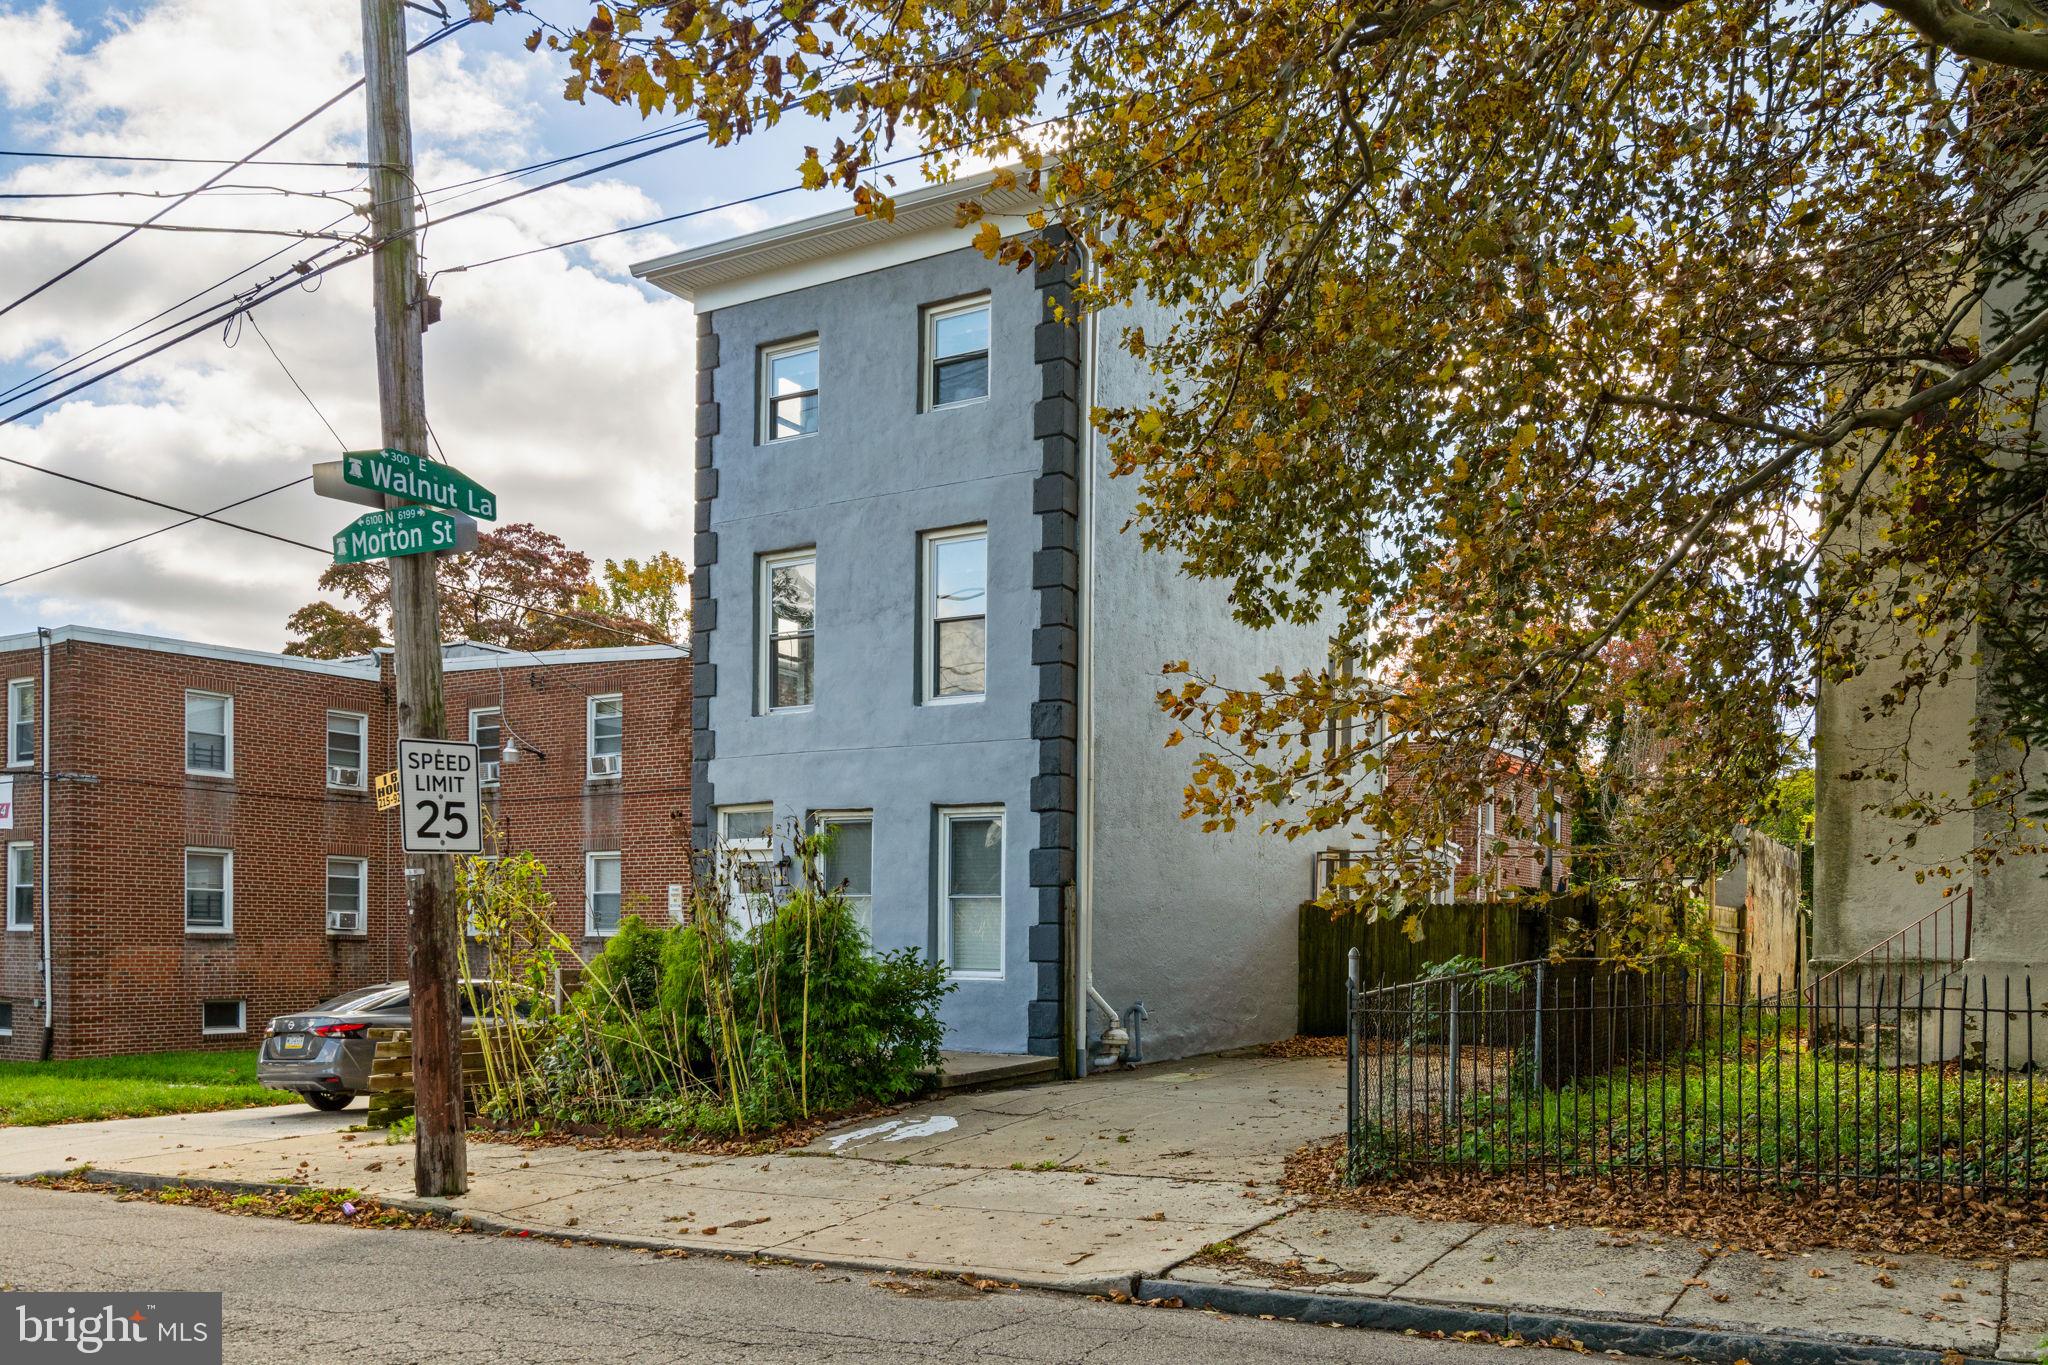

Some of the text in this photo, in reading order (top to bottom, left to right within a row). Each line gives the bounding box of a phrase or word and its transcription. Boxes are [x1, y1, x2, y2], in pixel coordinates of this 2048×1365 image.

[391, 452, 427, 472] 300 E
[369, 459, 493, 516] Walnut La
[365, 509, 416, 526] 6100 N 6199
[351, 520, 453, 557] Morton St
[408, 752, 471, 772] SPEED
[377, 781, 400, 798] HOU
[415, 774, 465, 793] LIMIT
[416, 799, 469, 840] 25
